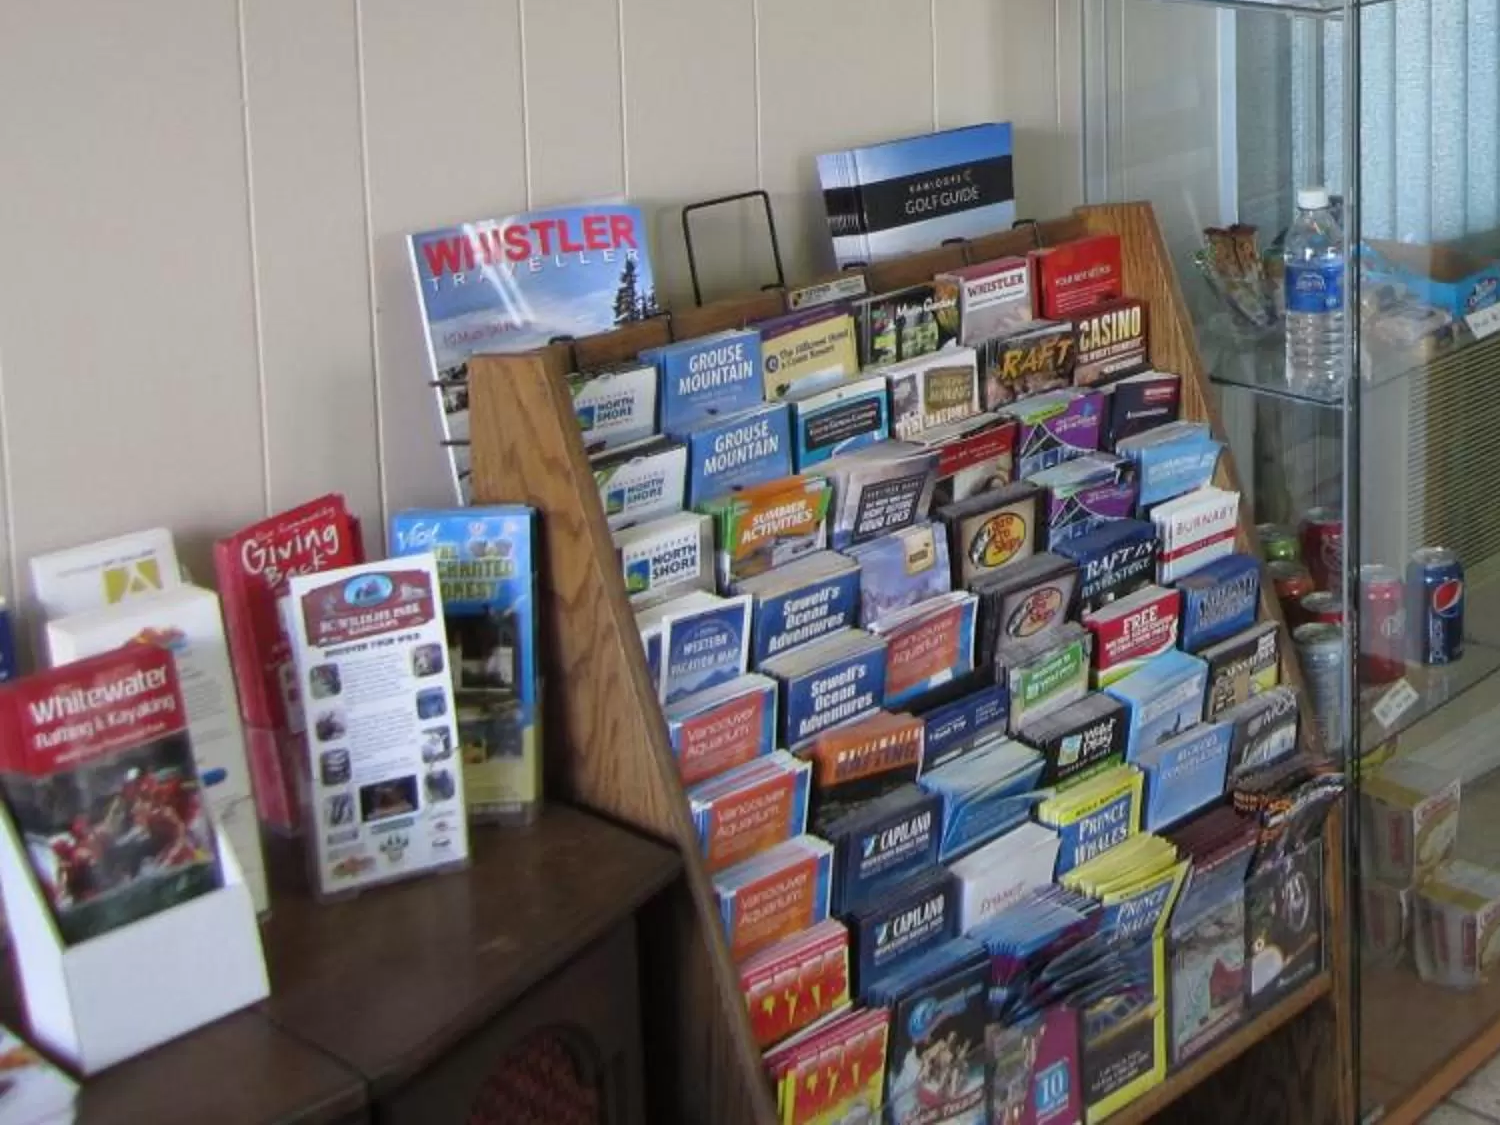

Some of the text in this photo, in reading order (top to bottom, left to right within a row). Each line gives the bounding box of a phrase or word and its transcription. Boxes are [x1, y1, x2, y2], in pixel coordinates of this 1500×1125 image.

[905, 185, 981, 215] GOLF GUIDE
[424, 214, 638, 277] WHISTLER
[967, 272, 1024, 298] WHISTLER
[1079, 305, 1141, 352] CASINO
[689, 342, 744, 372] GROUSE
[1002, 337, 1074, 380] RAFT
[678, 360, 753, 396] MOUNTAIN
[597, 395, 635, 411] NORTH
[597, 405, 633, 422] SHORE
[714, 419, 769, 454] GROUSE
[703, 434, 779, 476] MOUNTAIN
[626, 477, 665, 494] NORTH
[626, 486, 663, 505] SHORE
[741, 508, 813, 545] ACTIVITIES
[751, 499, 806, 527] SUMMER
[241, 523, 339, 574] Giving
[652, 542, 698, 566] NORTH
[1087, 546, 1135, 581] RAFT
[652, 556, 697, 580] SHORE
[783, 585, 841, 616] Sewell's
[784, 602, 829, 630] Ocean
[768, 612, 845, 654] Adventures
[1123, 604, 1159, 635] FREE
[29, 664, 167, 725] Whitewater
[810, 661, 868, 698] Sewell's
[107, 693, 176, 726] Kayaking
[814, 684, 856, 712] Ocean
[799, 694, 873, 737] Adventures
[880, 811, 931, 851] CAPILANO
[1079, 800, 1128, 842] PRINCE
[893, 894, 945, 937] CAPILANO
[1041, 1073, 1064, 1105] 10
